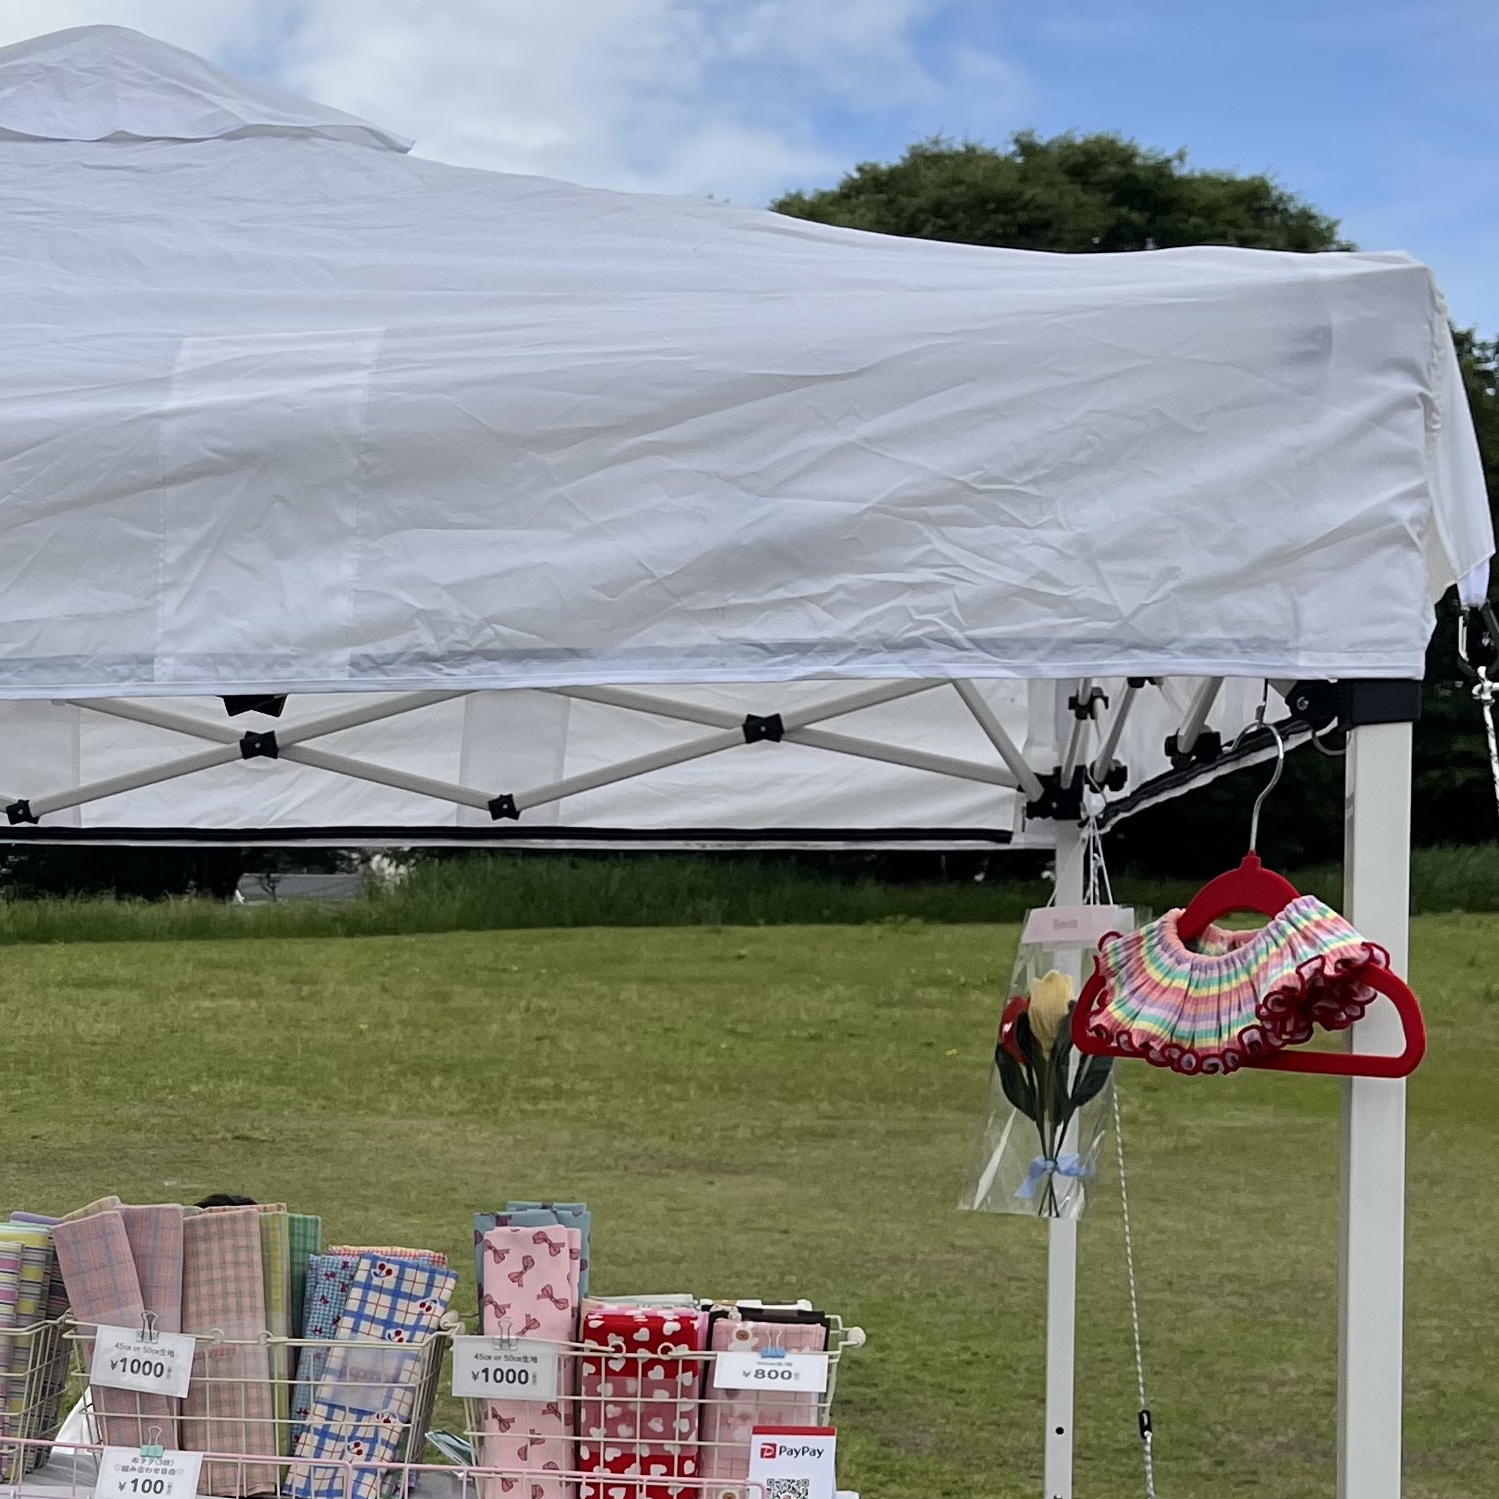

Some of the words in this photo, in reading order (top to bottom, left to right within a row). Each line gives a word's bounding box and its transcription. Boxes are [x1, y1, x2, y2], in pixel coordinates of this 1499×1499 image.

[110, 1357, 165, 1378] ¥1000
[471, 1367, 529, 1385] ¥1000
[742, 1368, 793, 1380] ¥800
[778, 1445, 824, 1459] PayPay
[118, 1478, 164, 1495] ¥100
